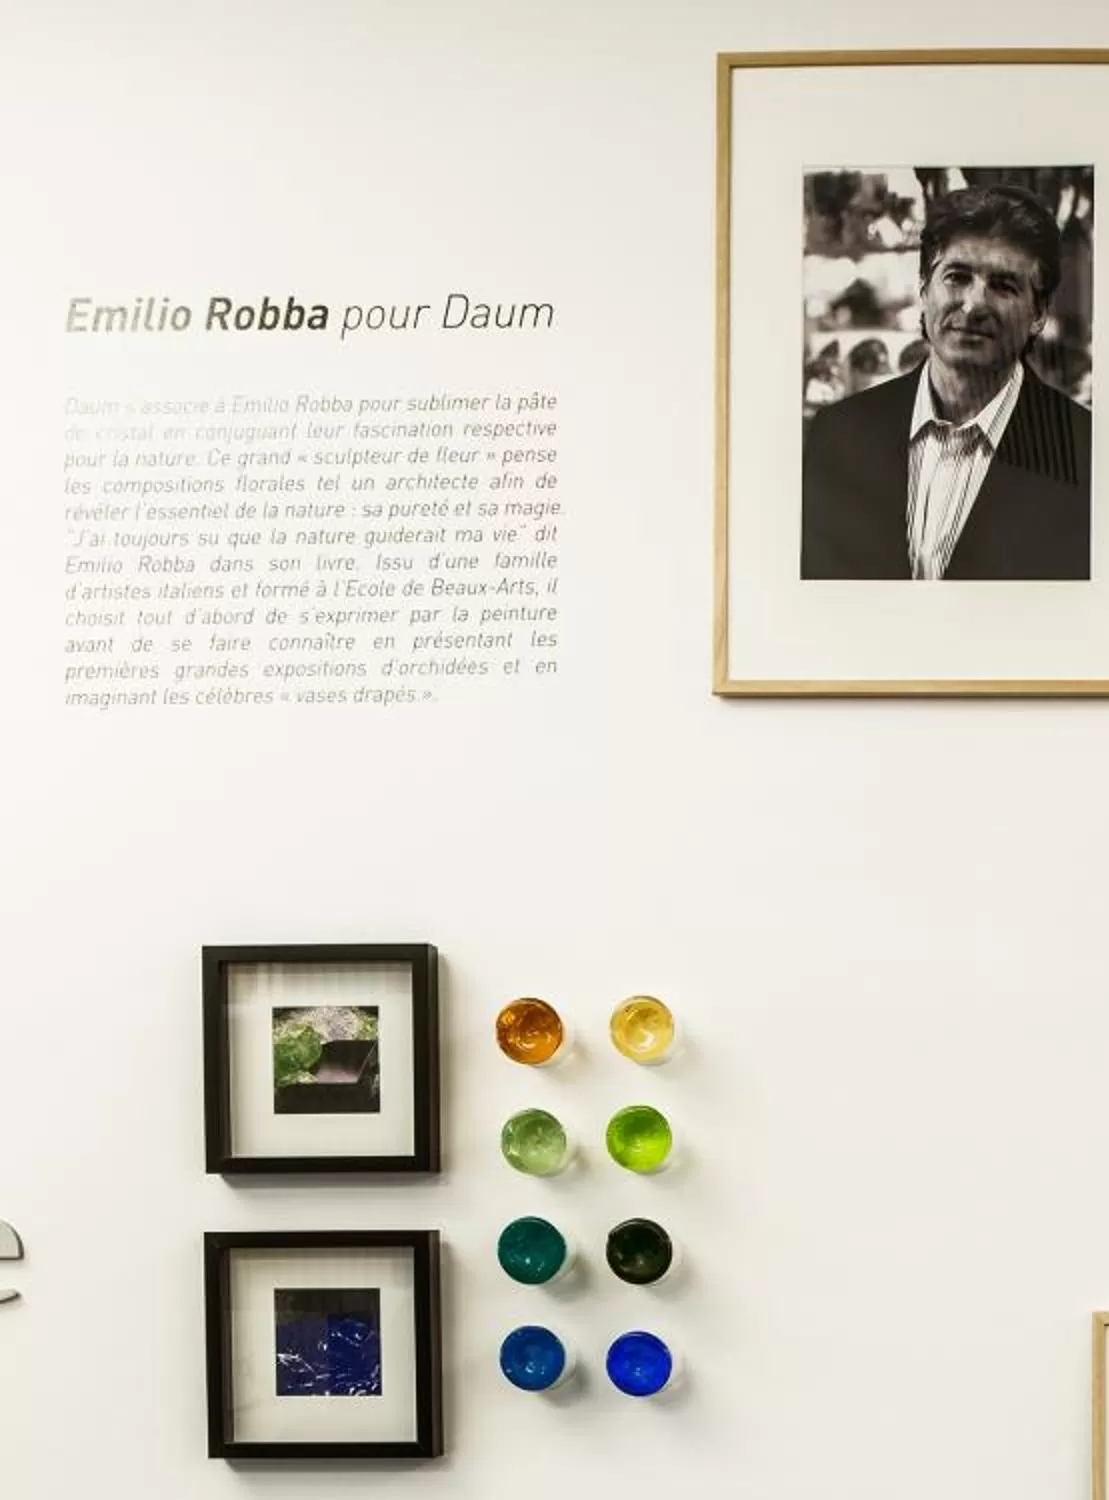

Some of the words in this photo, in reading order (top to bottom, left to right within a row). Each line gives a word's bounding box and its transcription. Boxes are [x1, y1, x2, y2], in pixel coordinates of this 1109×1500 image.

[65, 296, 191, 333] Emilio
[205, 295, 329, 331] Robba
[340, 304, 431, 340] pour
[441, 292, 553, 329] Daum
[157, 582, 225, 602] italiens
[230, 582, 249, 600] et
[315, 579, 327, 597] à
[401, 579, 424, 596] de
[431, 576, 539, 597] Beaux-Arts,
[546, 577, 558, 593] il
[64, 636, 113, 653] avant
[131, 637, 153, 653] de
[171, 638, 192, 652] se
[209, 633, 251, 651] faire
[268, 631, 355, 651] connaître
[372, 635, 395, 649] en
[530, 629, 557, 647] les
[174, 659, 249, 682] grandes
[263, 660, 367, 679] expositions
[502, 658, 520, 675] et
[534, 660, 557, 674] en
